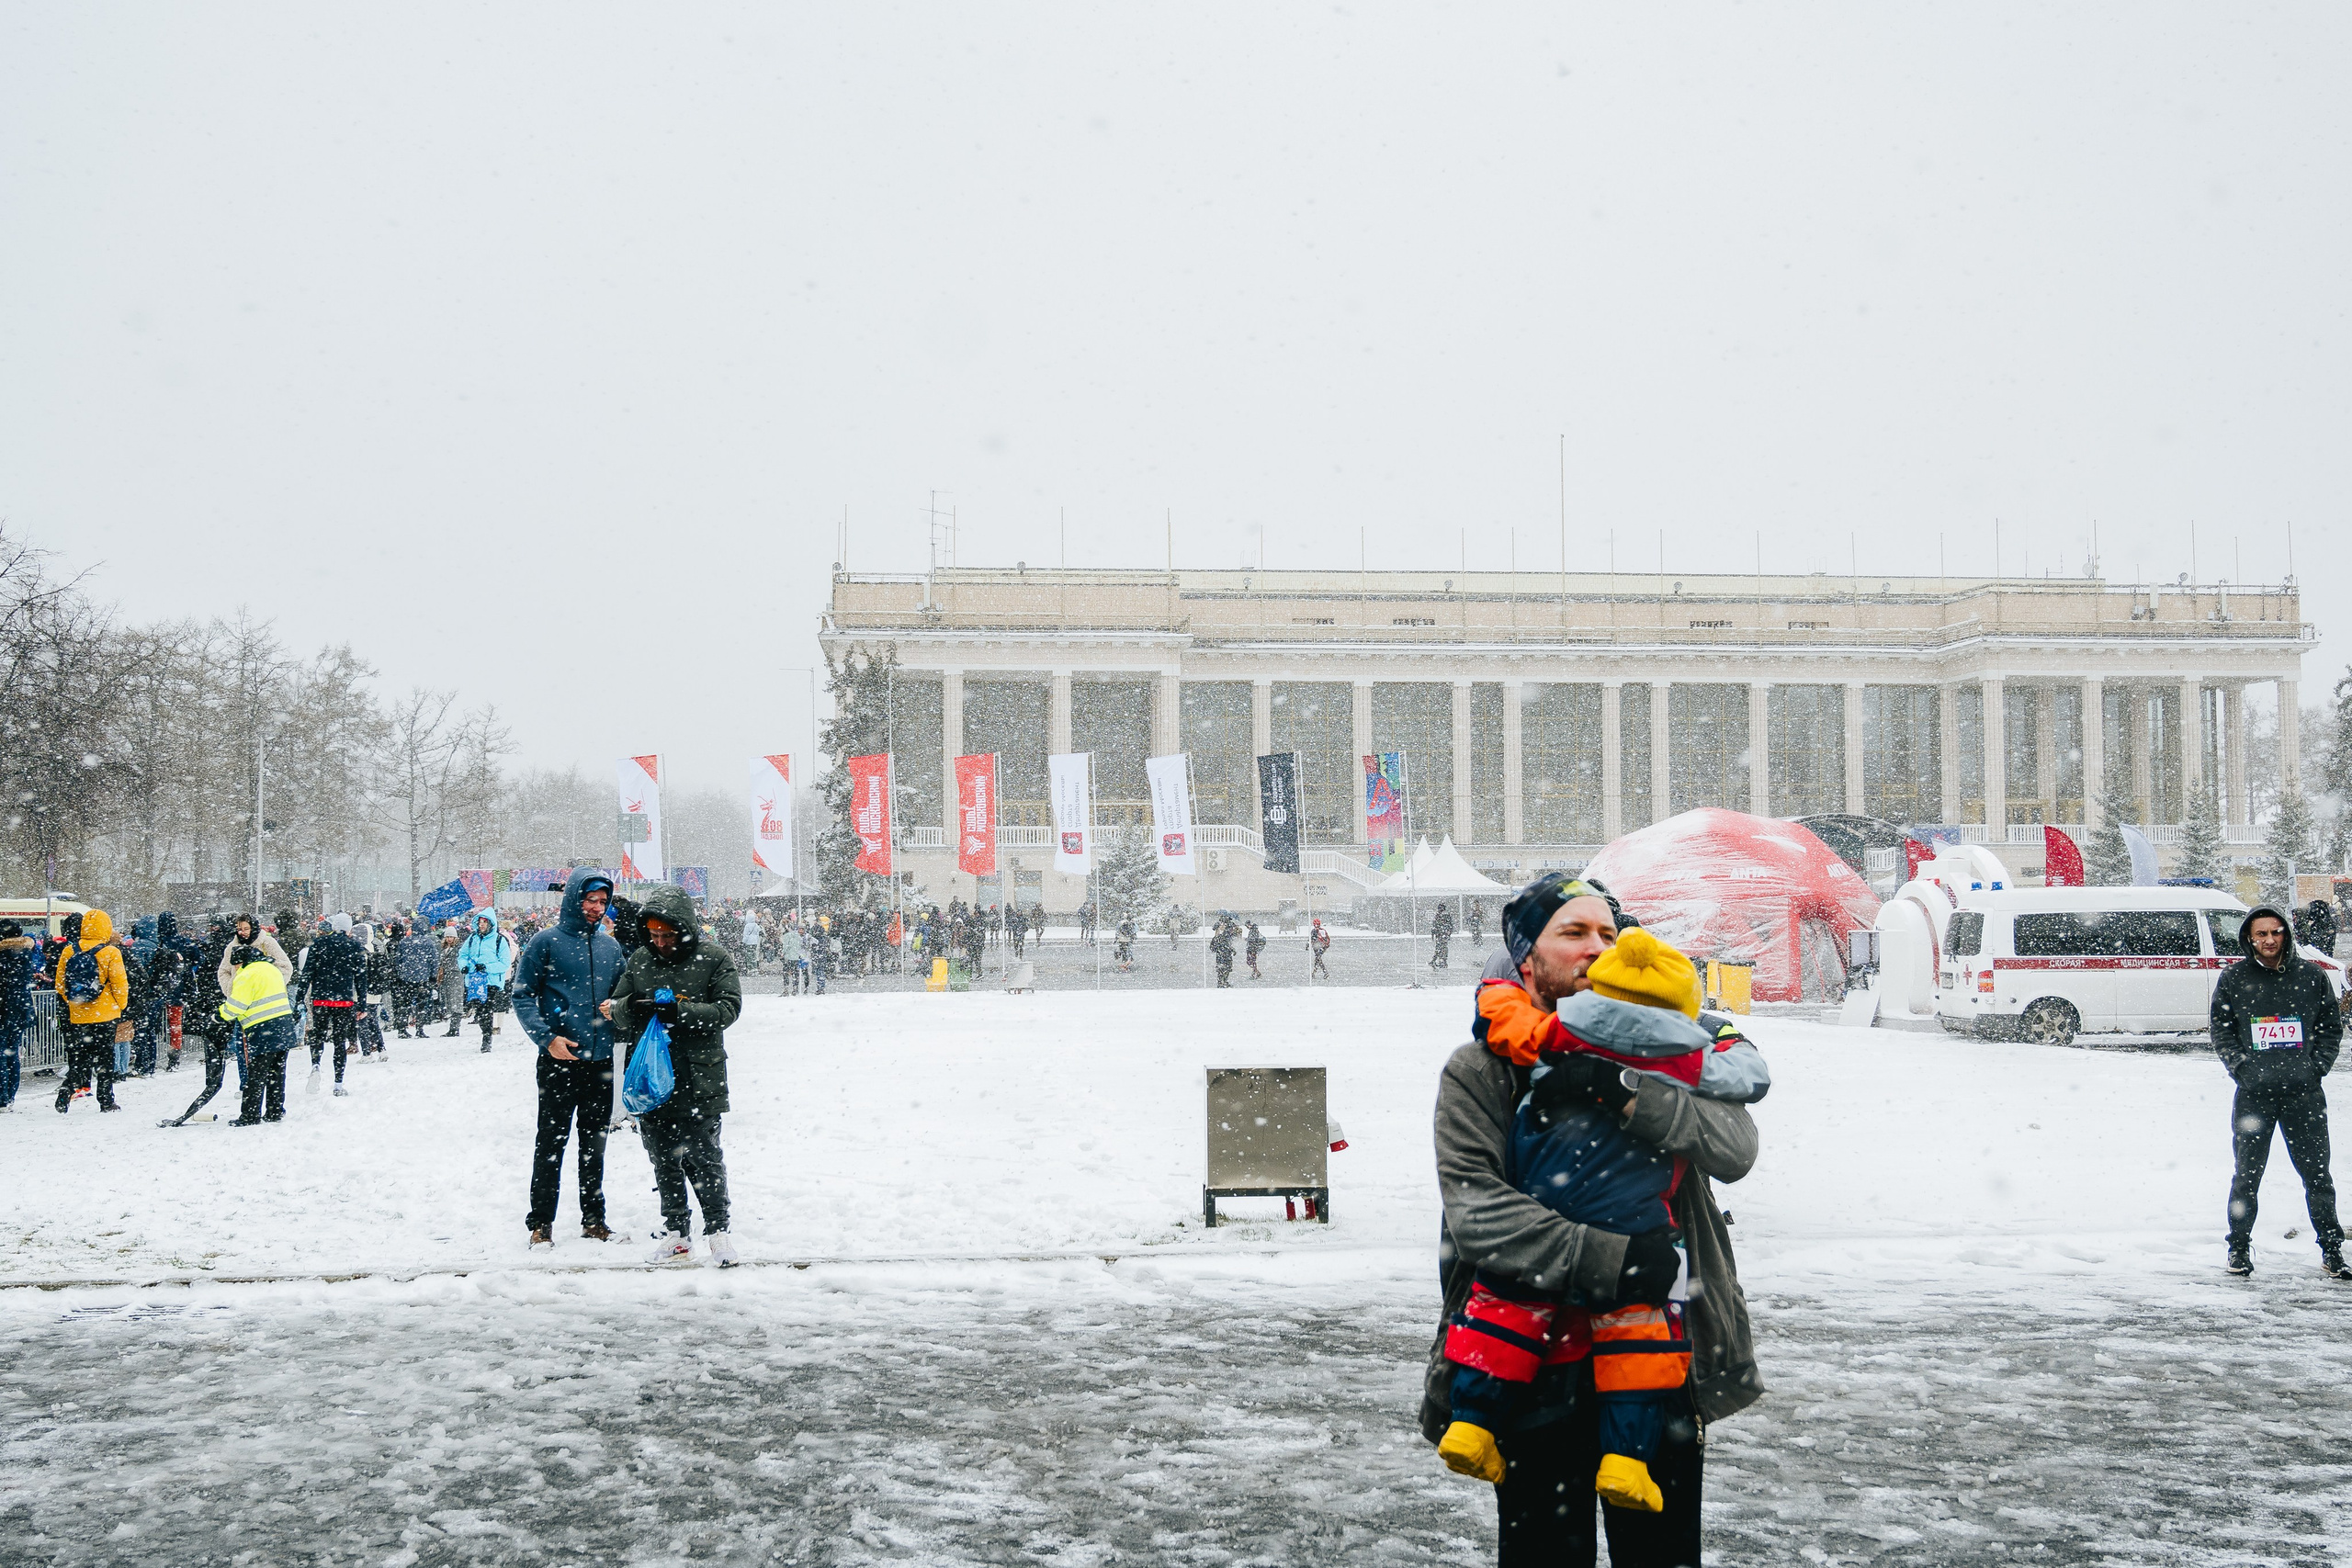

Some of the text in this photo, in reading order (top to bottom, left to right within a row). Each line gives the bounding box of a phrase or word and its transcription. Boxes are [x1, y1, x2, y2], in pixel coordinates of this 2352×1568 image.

[2049, 958, 2180, 967] СКОРАЯ МЕДИЦИНСКАЯ
[2258, 1025, 2296, 1039] 7419
